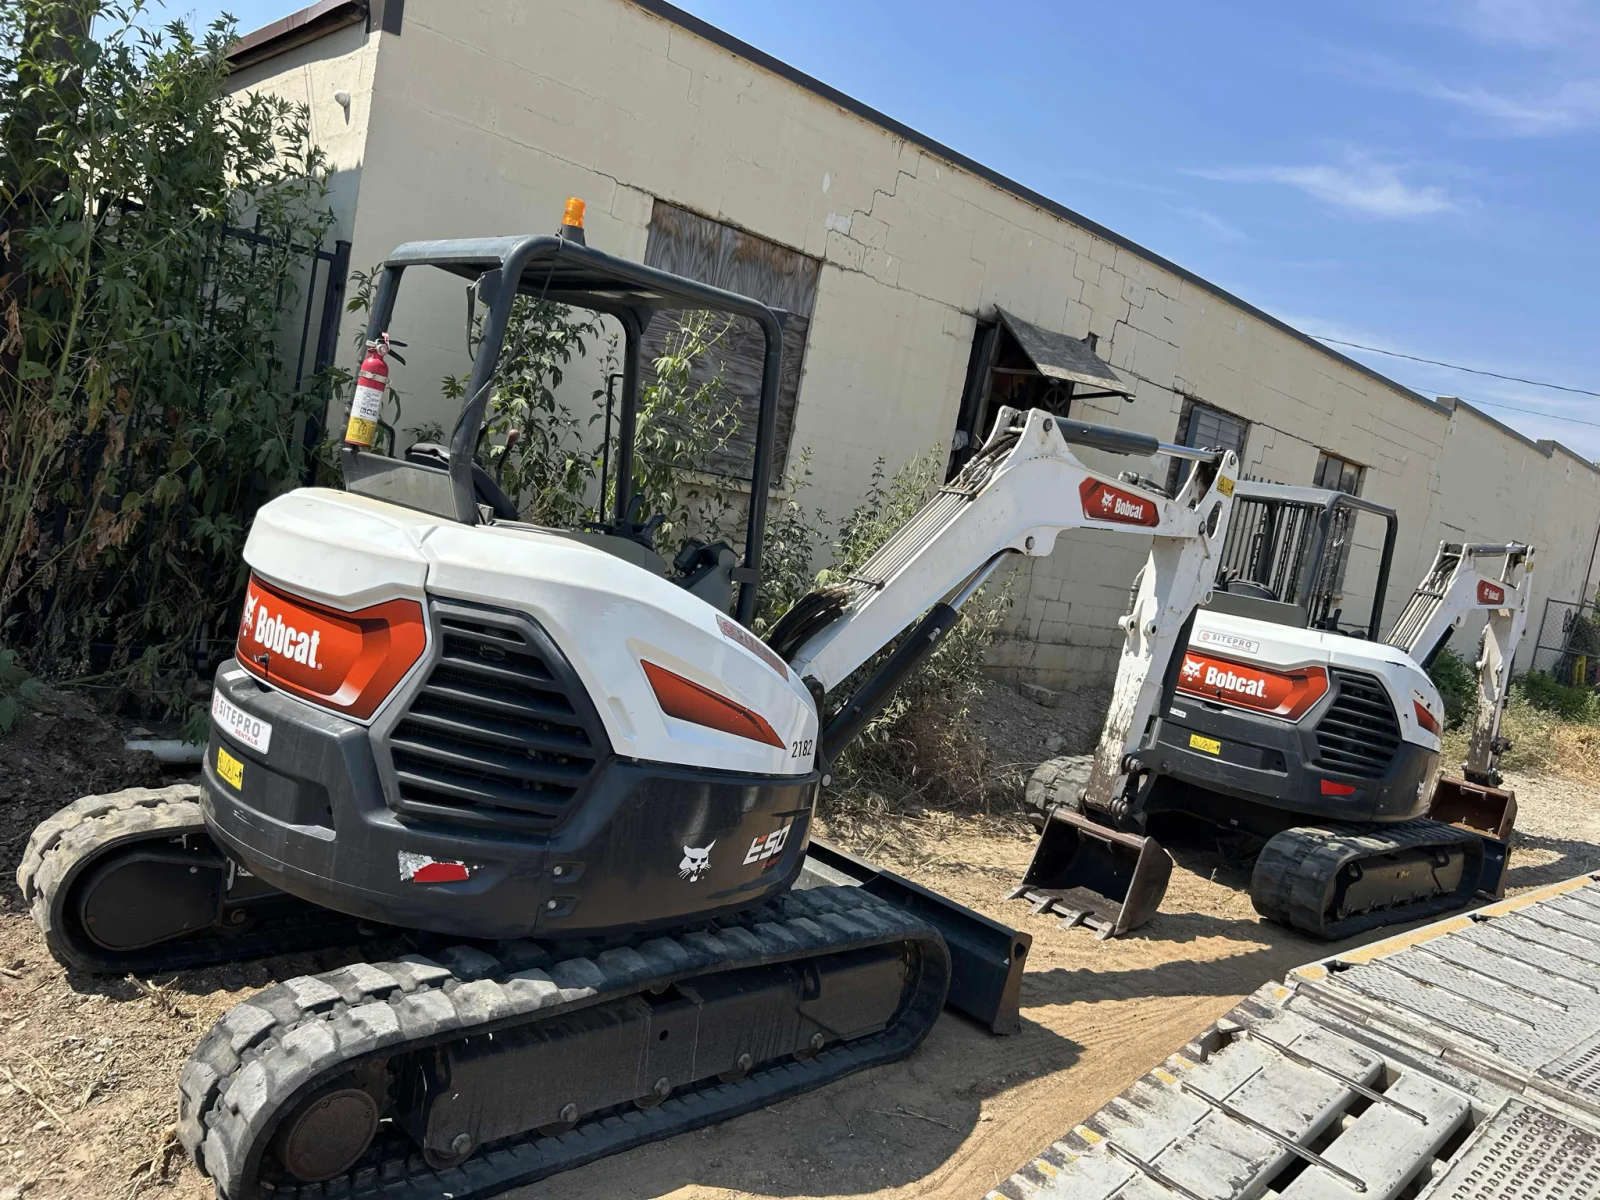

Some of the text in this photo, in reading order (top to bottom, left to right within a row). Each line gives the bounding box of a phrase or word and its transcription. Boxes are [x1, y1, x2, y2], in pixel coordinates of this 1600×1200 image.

[1114, 497, 1144, 520] Bobcat
[254, 604, 320, 669] Bobcat
[1211, 634, 1252, 648] SITEPRO
[1204, 666, 1265, 698] Bobcat
[219, 699, 261, 738] SITEPRO
[791, 739, 813, 759] 2182
[742, 824, 791, 866] E50
